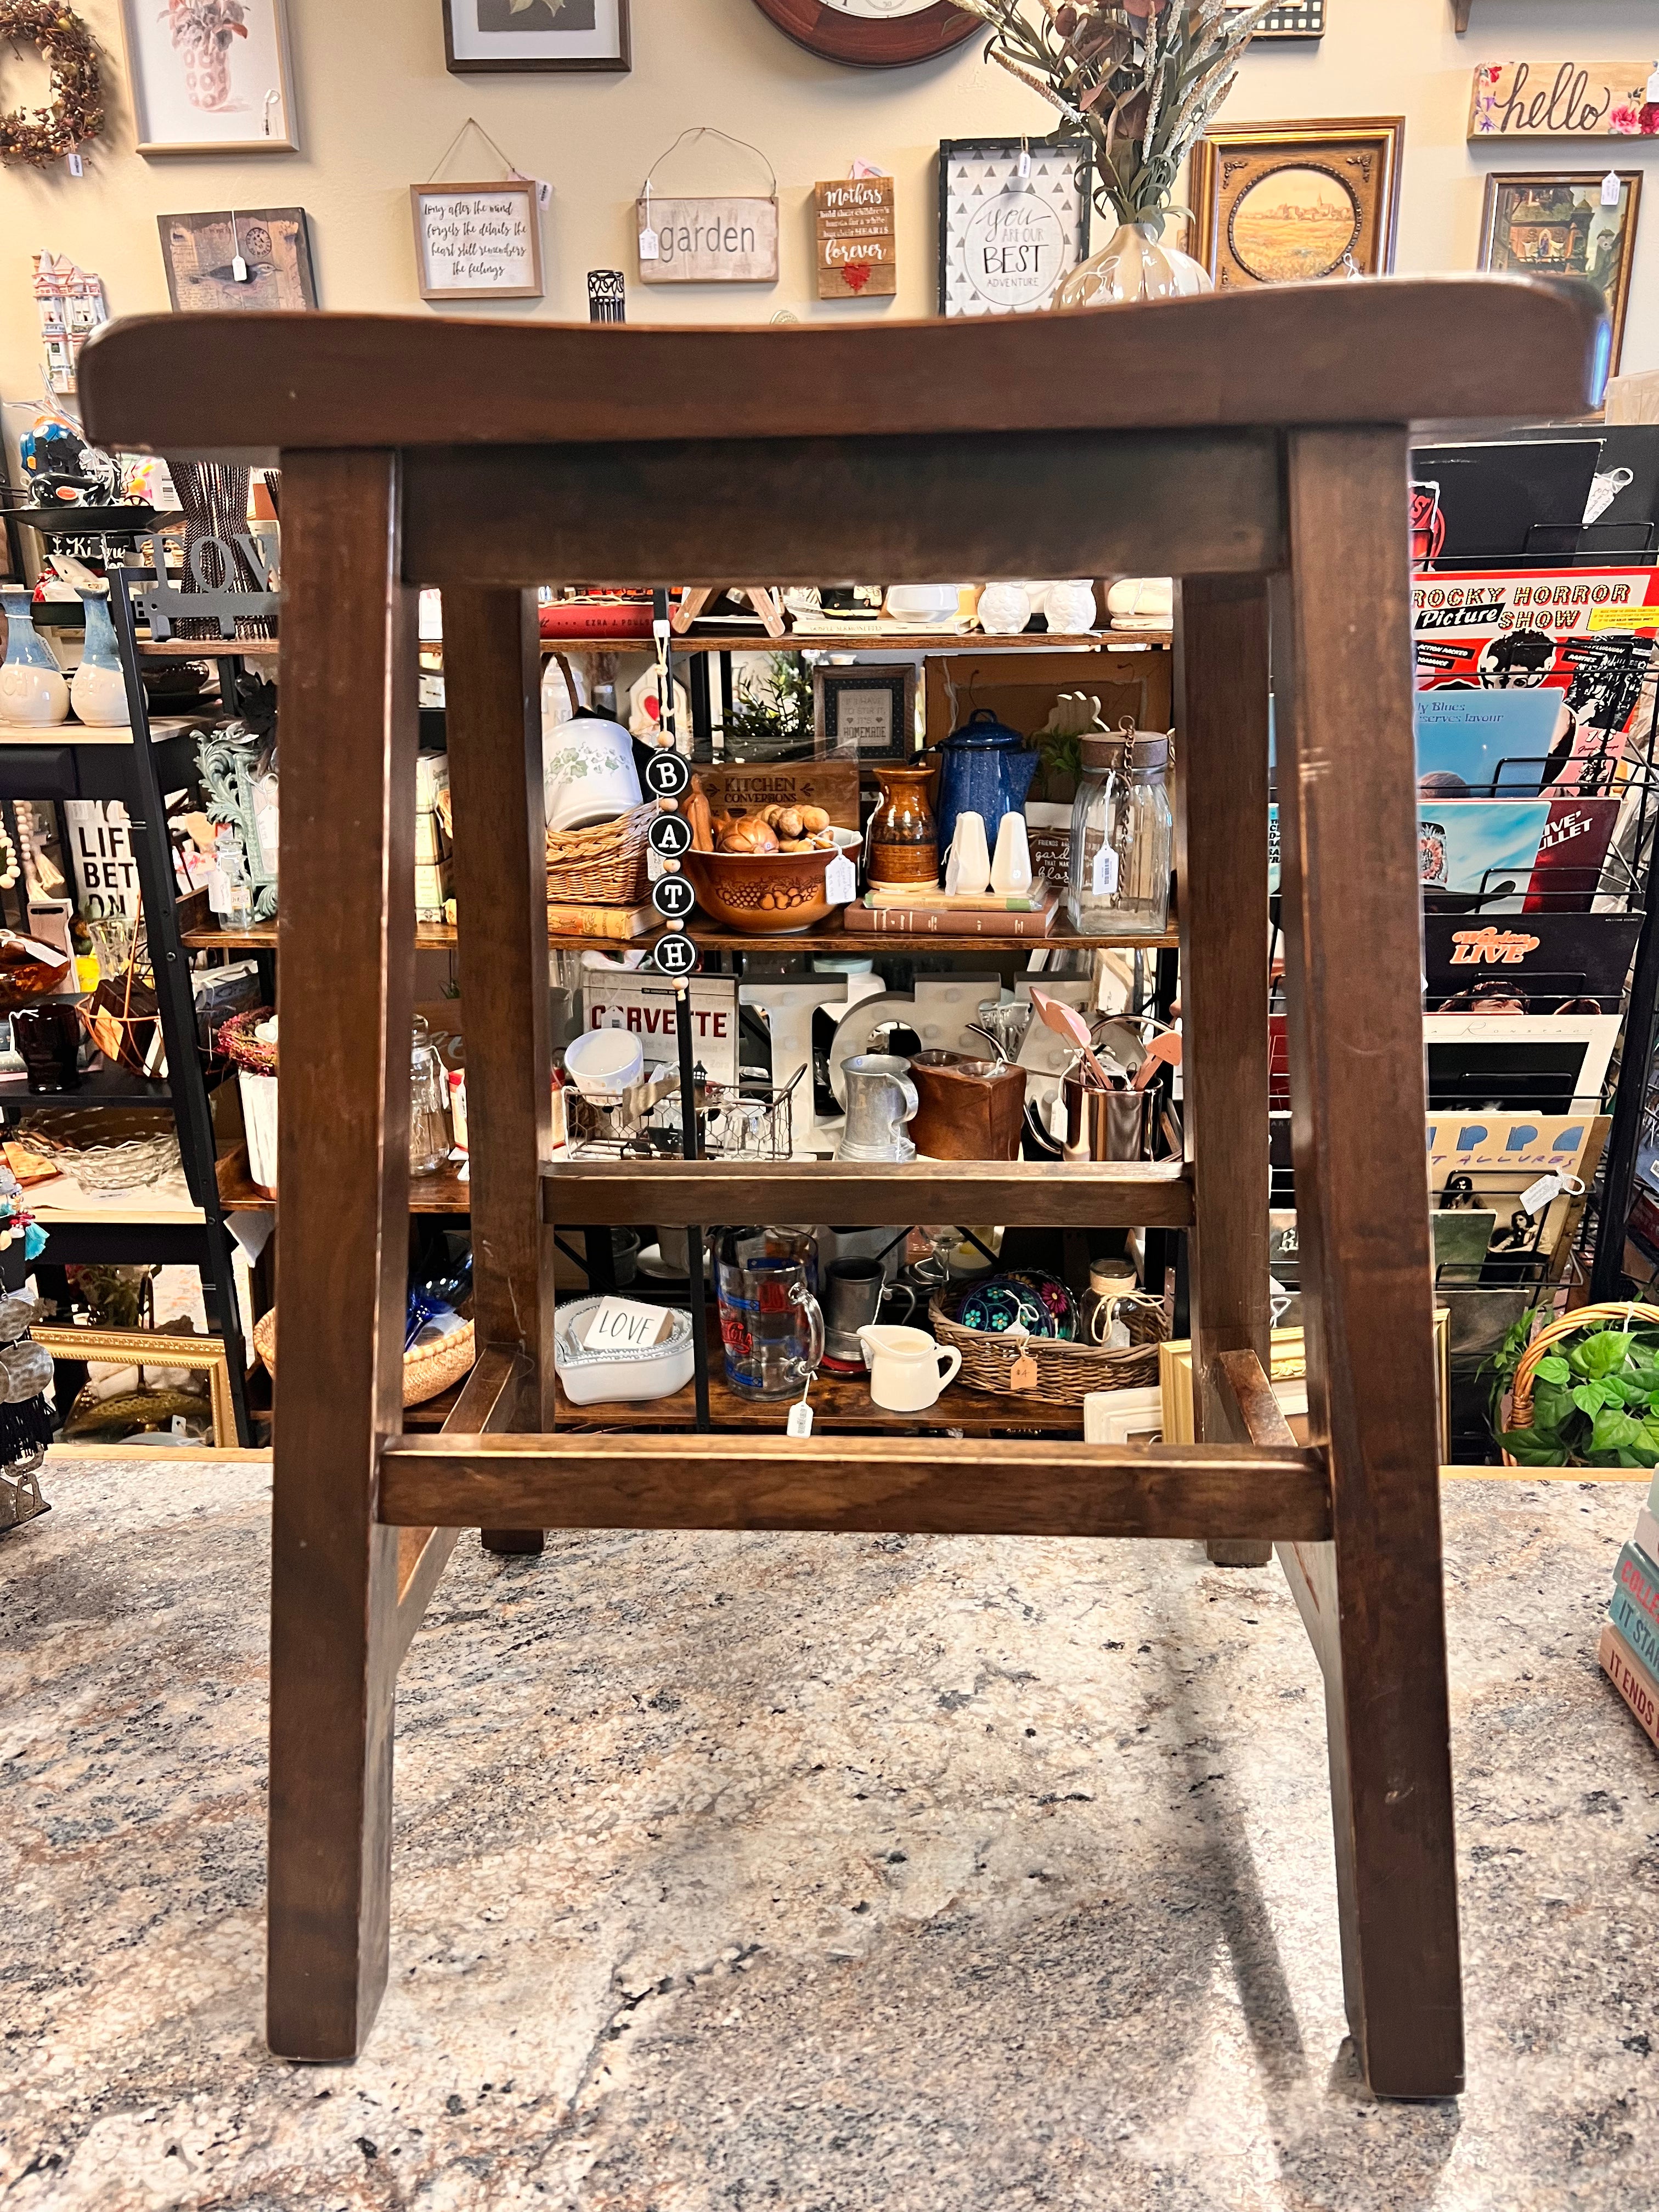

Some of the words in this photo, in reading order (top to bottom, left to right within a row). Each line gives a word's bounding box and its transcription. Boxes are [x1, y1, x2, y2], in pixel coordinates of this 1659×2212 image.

[1494, 62, 1611, 133] hello
[825, 183, 883, 207] Mothers
[449, 201, 471, 217] after
[474, 200, 487, 215] the
[489, 202, 513, 216] mind
[427, 222, 461, 241] forgets
[464, 221, 476, 236] the
[479, 222, 511, 236] details
[515, 221, 527, 236] the
[975, 207, 1051, 242] you
[1002, 228, 1019, 242] ARE
[1023, 228, 1044, 242] OUR
[431, 242, 454, 257] heart
[458, 242, 477, 257] still
[660, 216, 754, 263] garden
[825, 238, 887, 264] forever
[983, 244, 1049, 274] BEST
[453, 261, 466, 275] the
[469, 262, 506, 281] feelings
[987, 277, 1040, 287] ADVENTURE
[1412, 587, 1506, 607] ROCKY
[1513, 584, 1632, 606] HORROR
[621, 618, 650, 627] POULS
[1421, 607, 1499, 627] Picture
[1498, 610, 1582, 630] SHOW
[1432, 702, 1466, 712] Blues
[843, 726, 887, 738] HOMEMADE
[724, 777, 795, 792] KITCHEN
[724, 793, 797, 803] CONVERSIONS
[1538, 817, 1593, 852] ULLET
[1449, 944, 1525, 964] LIVE
[591, 1005, 728, 1038] CRVETE
[1457, 1154, 1576, 1167] ALLURES
[599, 1310, 655, 1345] LOVE
[1619, 1599, 1634, 1628] IT
[1610, 1648, 1622, 1678] IT
[1622, 1666, 1655, 1726] ENDS
